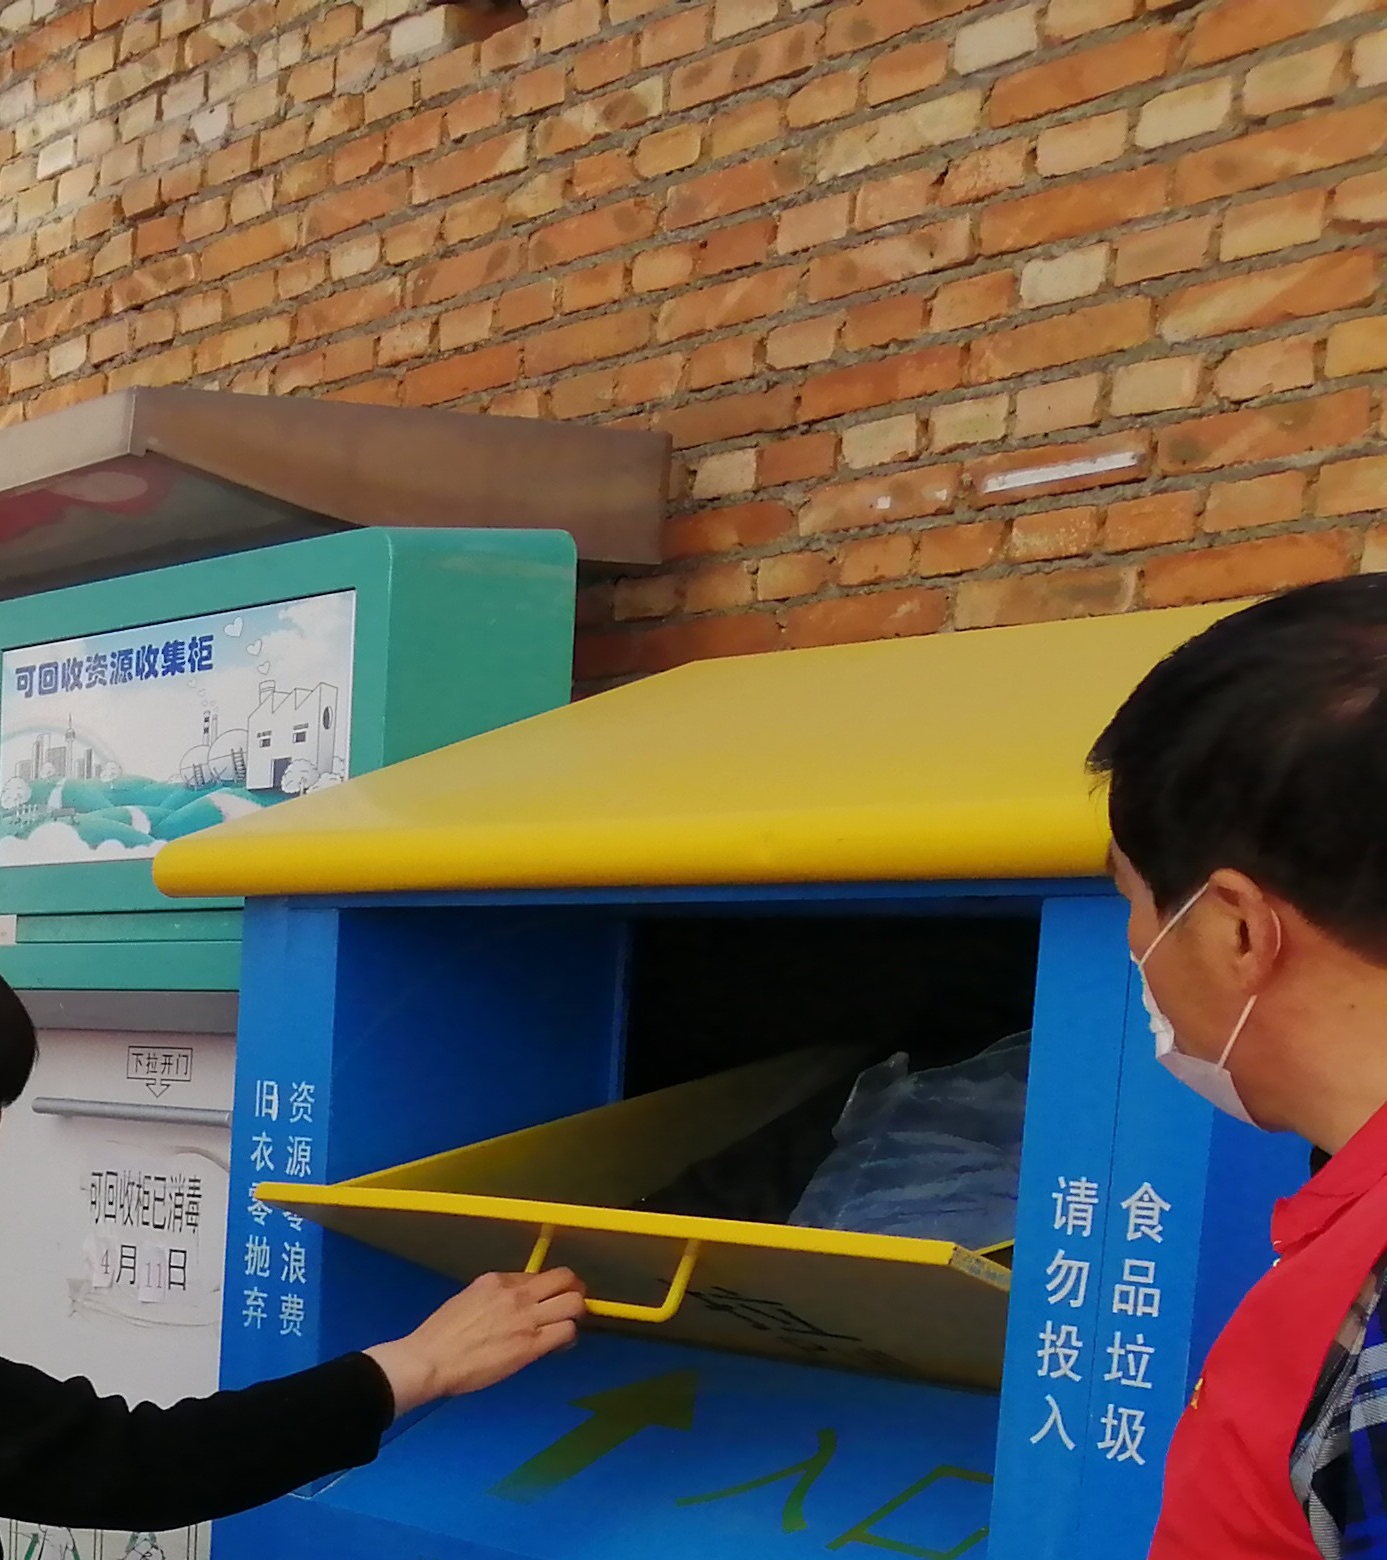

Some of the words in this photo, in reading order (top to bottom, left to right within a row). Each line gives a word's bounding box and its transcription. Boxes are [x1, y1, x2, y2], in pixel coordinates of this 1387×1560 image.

[14, 634, 215, 696] 可回收资源收集柜
[131, 1051, 190, 1080] 下拉开门
[89, 1170, 203, 1235] 可回收柜已消毒
[1030, 1176, 1099, 1451] 请勿投入
[1097, 1181, 1172, 1466] 食品垃圾
